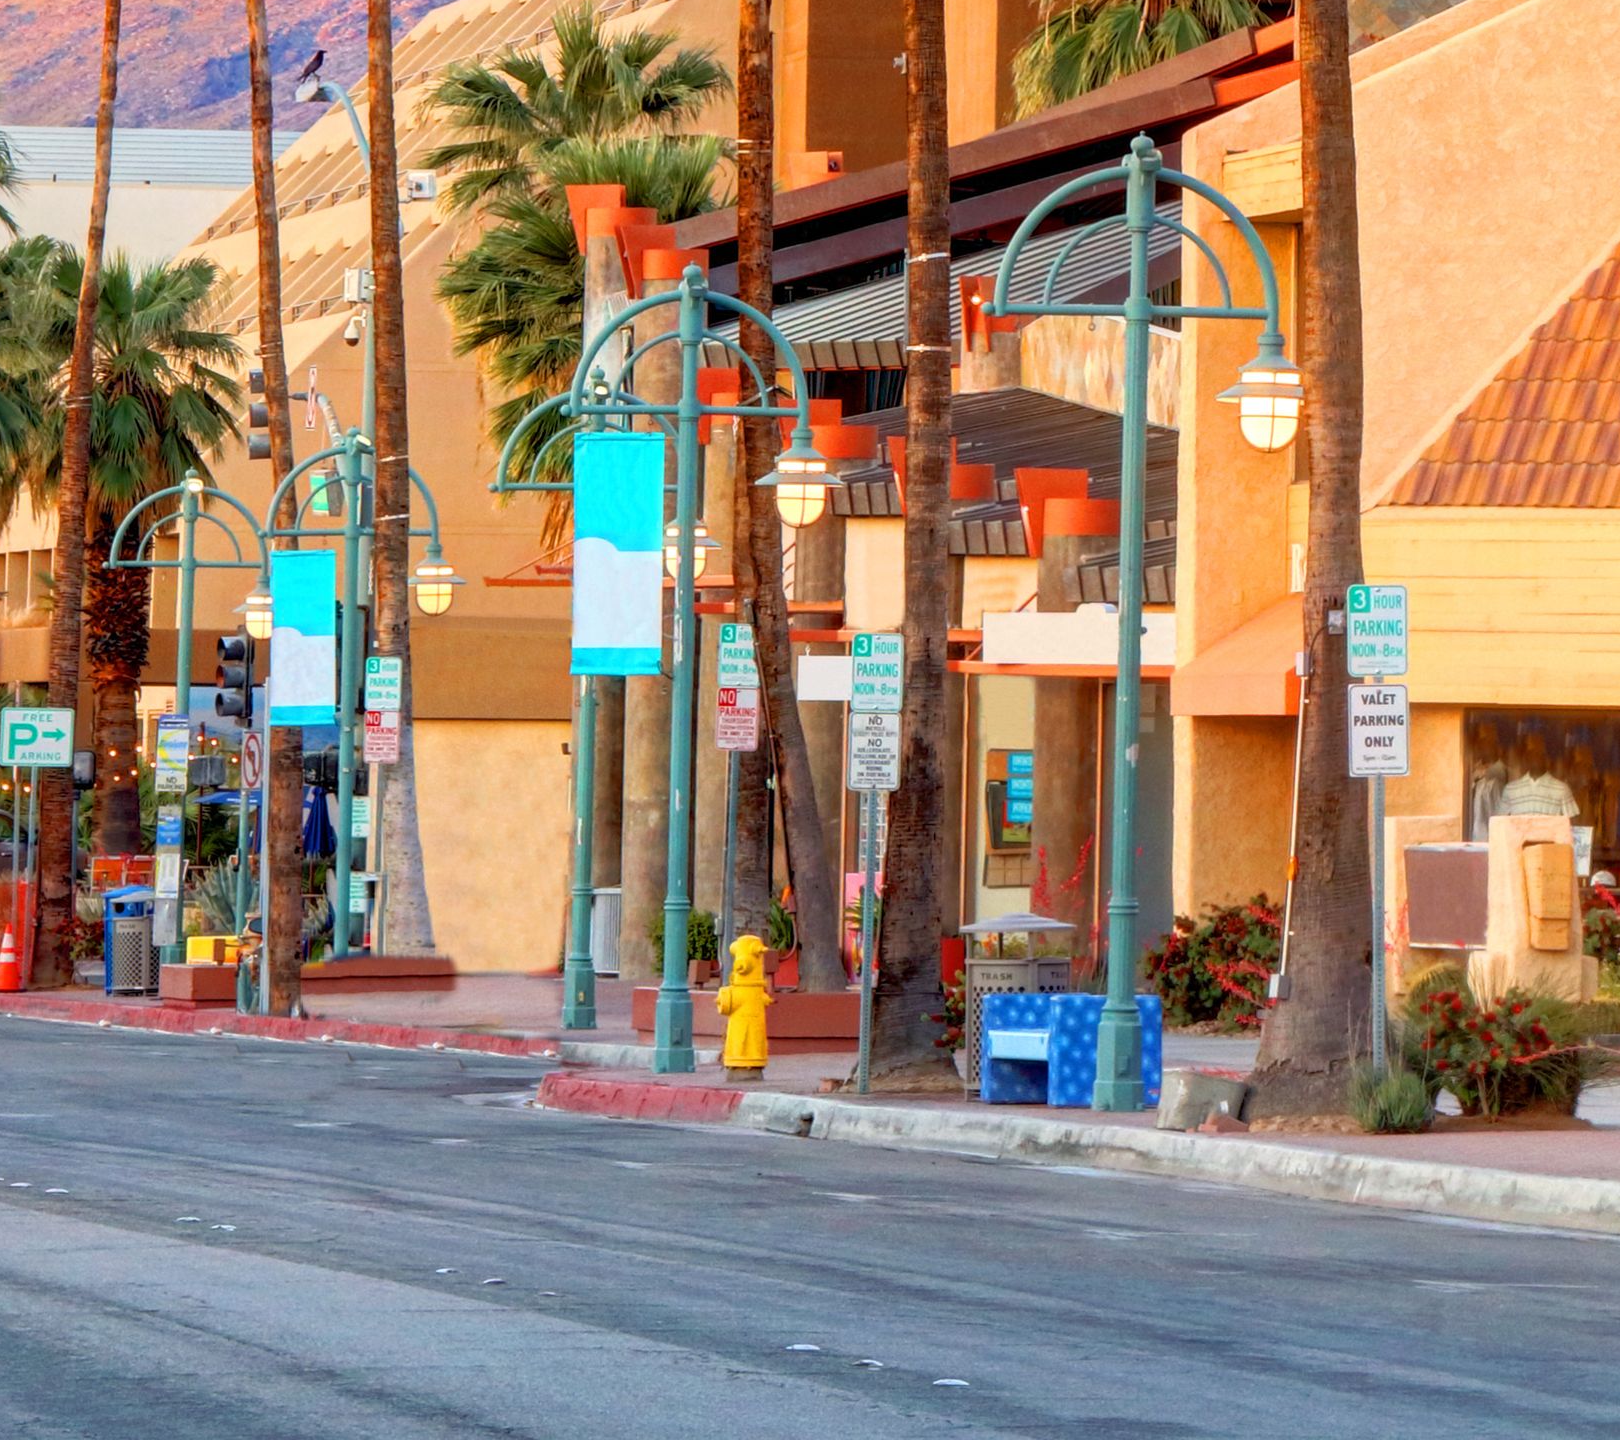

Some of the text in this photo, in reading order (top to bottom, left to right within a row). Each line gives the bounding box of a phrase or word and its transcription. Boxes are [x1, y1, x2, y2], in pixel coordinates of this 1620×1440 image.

[1354, 590, 1402, 610] 3 HOUR
[724, 626, 733, 640] 3
[1354, 620, 1403, 636] PARKING
[857, 637, 899, 654] 3 HOUR
[1352, 644, 1376, 657] NOON
[370, 660, 378, 671] 3
[722, 664, 738, 673] NOON
[857, 663, 898, 677] PARKING
[370, 678, 398, 686] PARKING
[854, 683, 875, 695] NOON
[720, 690, 735, 704] NO
[1361, 694, 1396, 705] VALET
[22, 713, 53, 722] FREE
[718, 708, 755, 717] PARKING
[366, 713, 380, 724] NO
[868, 716, 883, 725] NO
[1354, 715, 1404, 726] PARKING
[366, 727, 396, 735] PARKING
[868, 738, 882, 747] NO
[1364, 736, 1394, 747] ONLY
